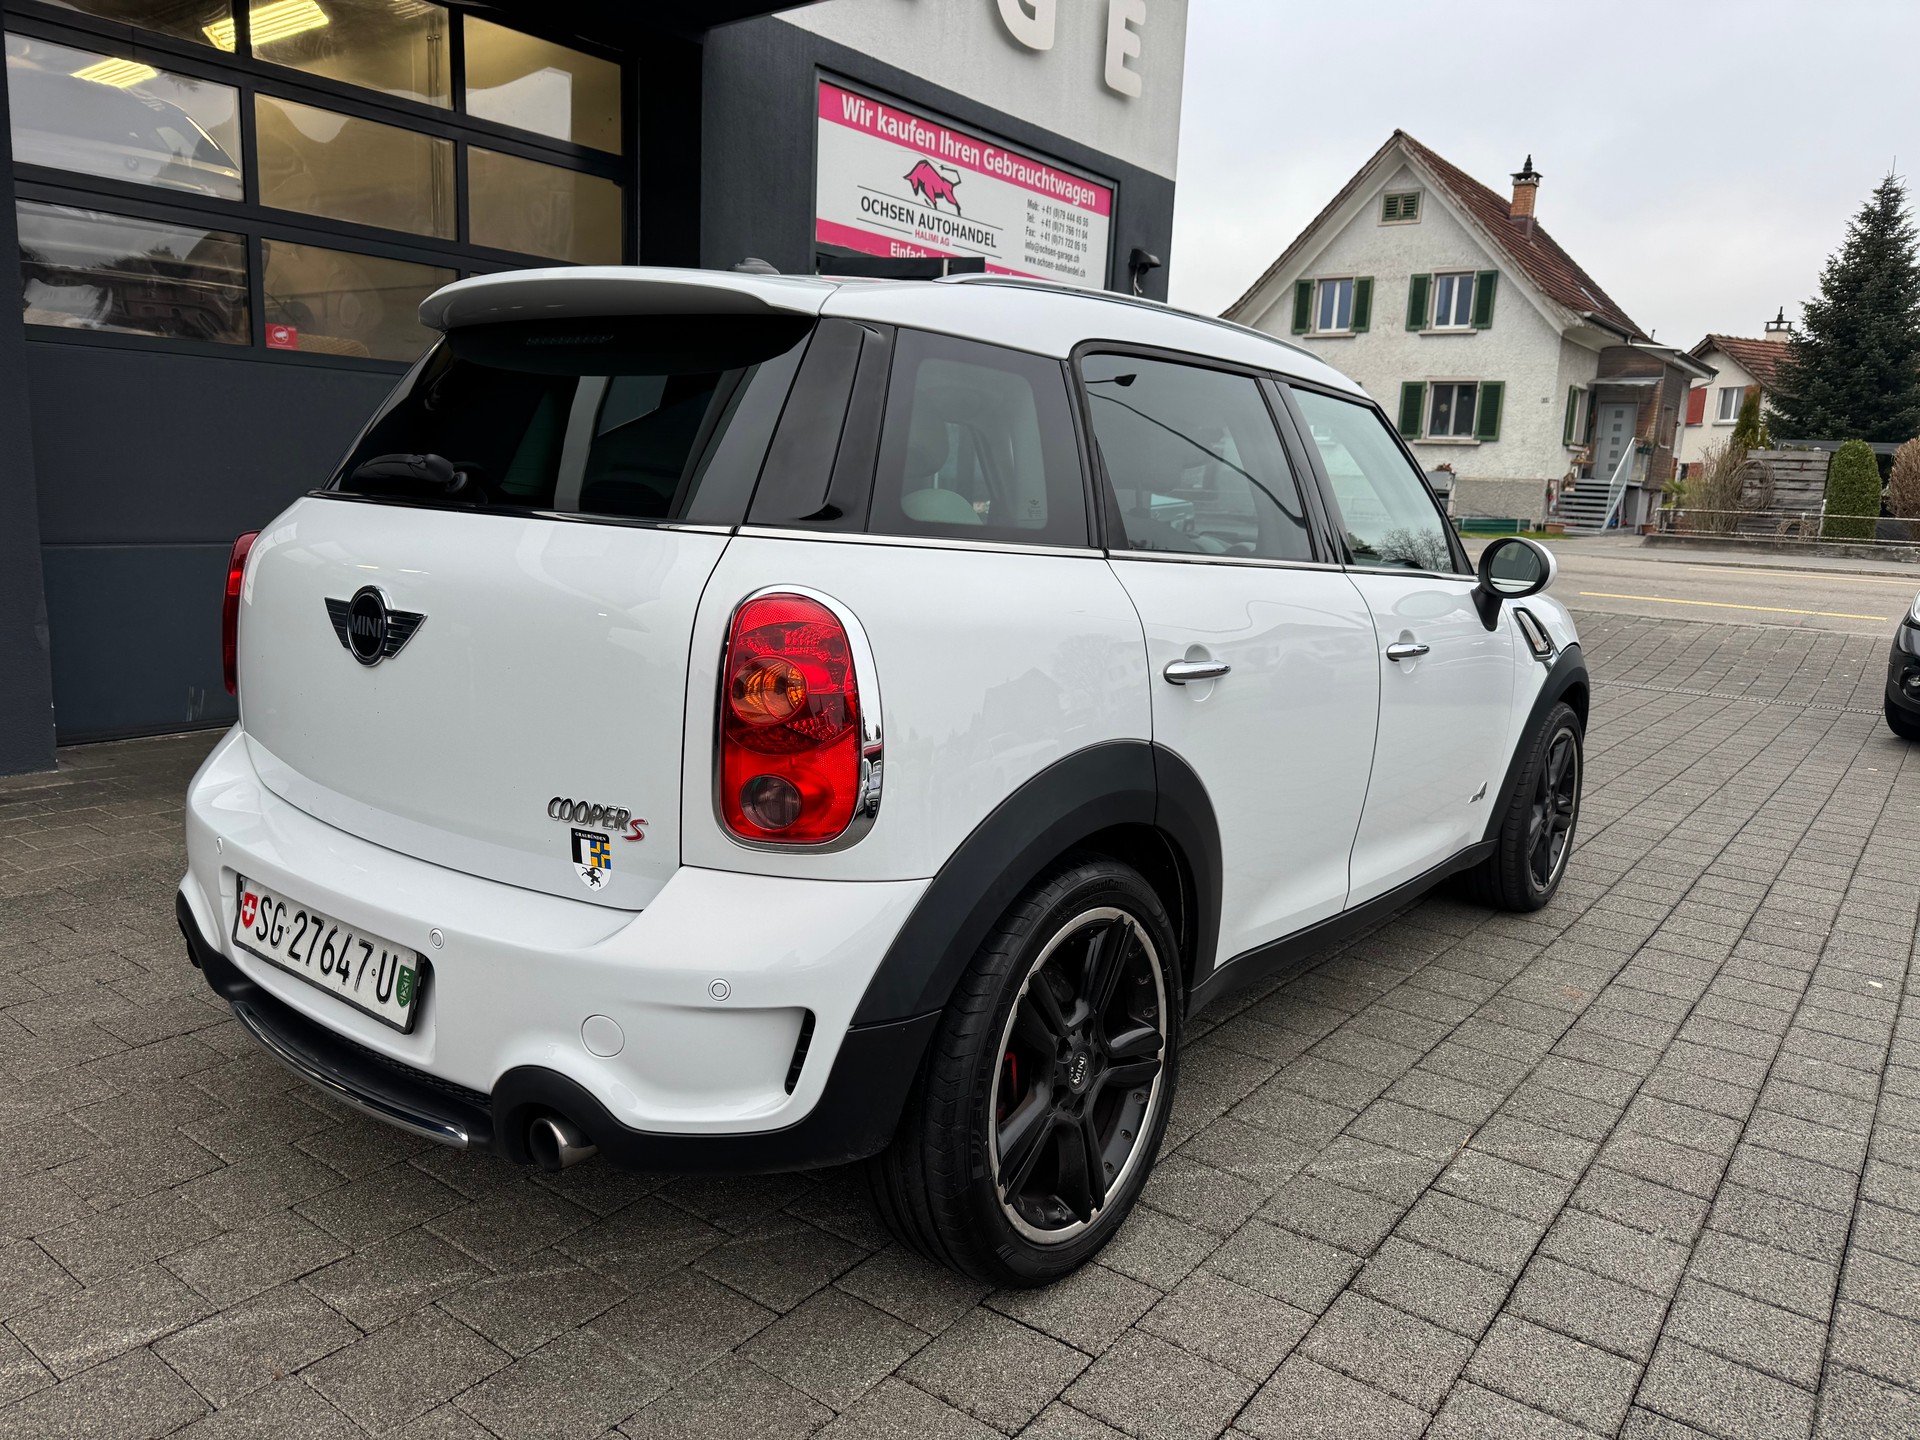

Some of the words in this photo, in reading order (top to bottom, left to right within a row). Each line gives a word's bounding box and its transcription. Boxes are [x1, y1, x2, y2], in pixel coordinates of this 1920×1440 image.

[842, 94, 873, 127] Wir
[877, 106, 935, 150] kaufen
[939, 131, 980, 166] Ihren
[983, 148, 1096, 206] Gebrauchtwagen
[861, 196, 914, 225] OCHSEN
[918, 213, 996, 248] AUTOHANDEL
[915, 229, 939, 244] HALIMI
[940, 237, 950, 247] AG
[350, 613, 382, 638] MINI
[547, 796, 631, 832] COOPER
[621, 819, 649, 842] S
[1073, 1056, 1085, 1084] MINI
